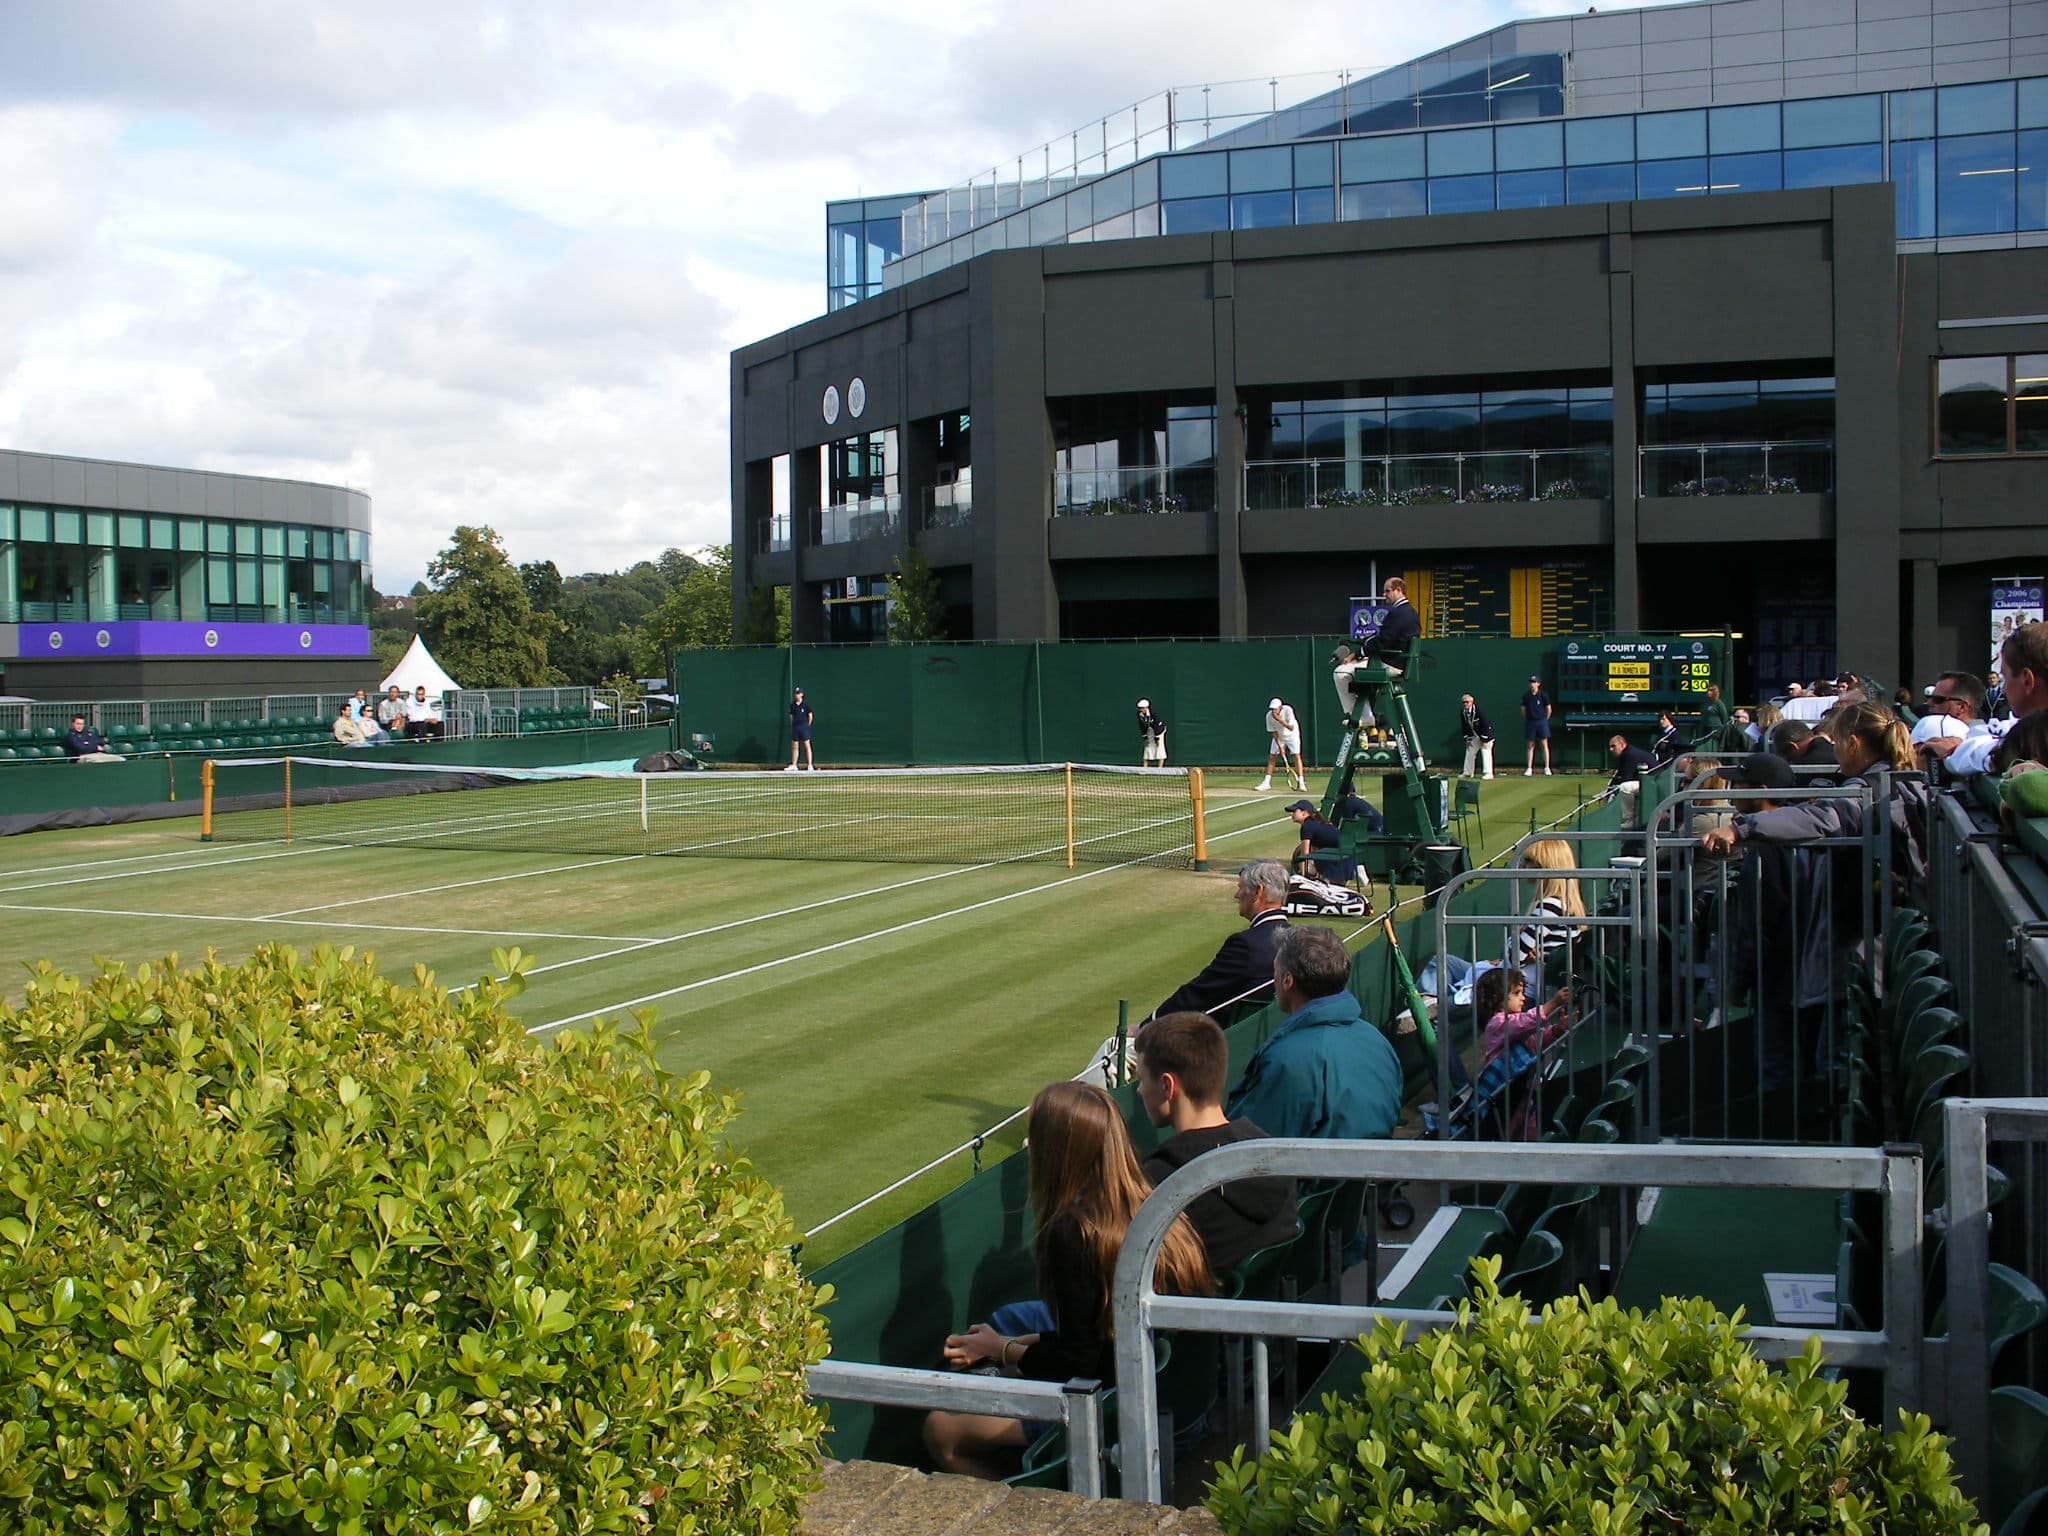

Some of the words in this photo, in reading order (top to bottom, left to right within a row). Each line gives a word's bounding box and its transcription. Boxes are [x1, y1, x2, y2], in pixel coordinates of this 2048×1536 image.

[1995, 599, 2040, 609] Champions
[1604, 644, 1636, 652] COURT
[1637, 644, 1654, 652] NO.
[1656, 644, 1667, 652] 17
[1681, 664, 1690, 675] 2
[1693, 664, 1710, 674] 40
[1681, 681, 1690, 690] 2
[1692, 680, 1709, 690] 30
[1280, 903, 1364, 916] HEAD
